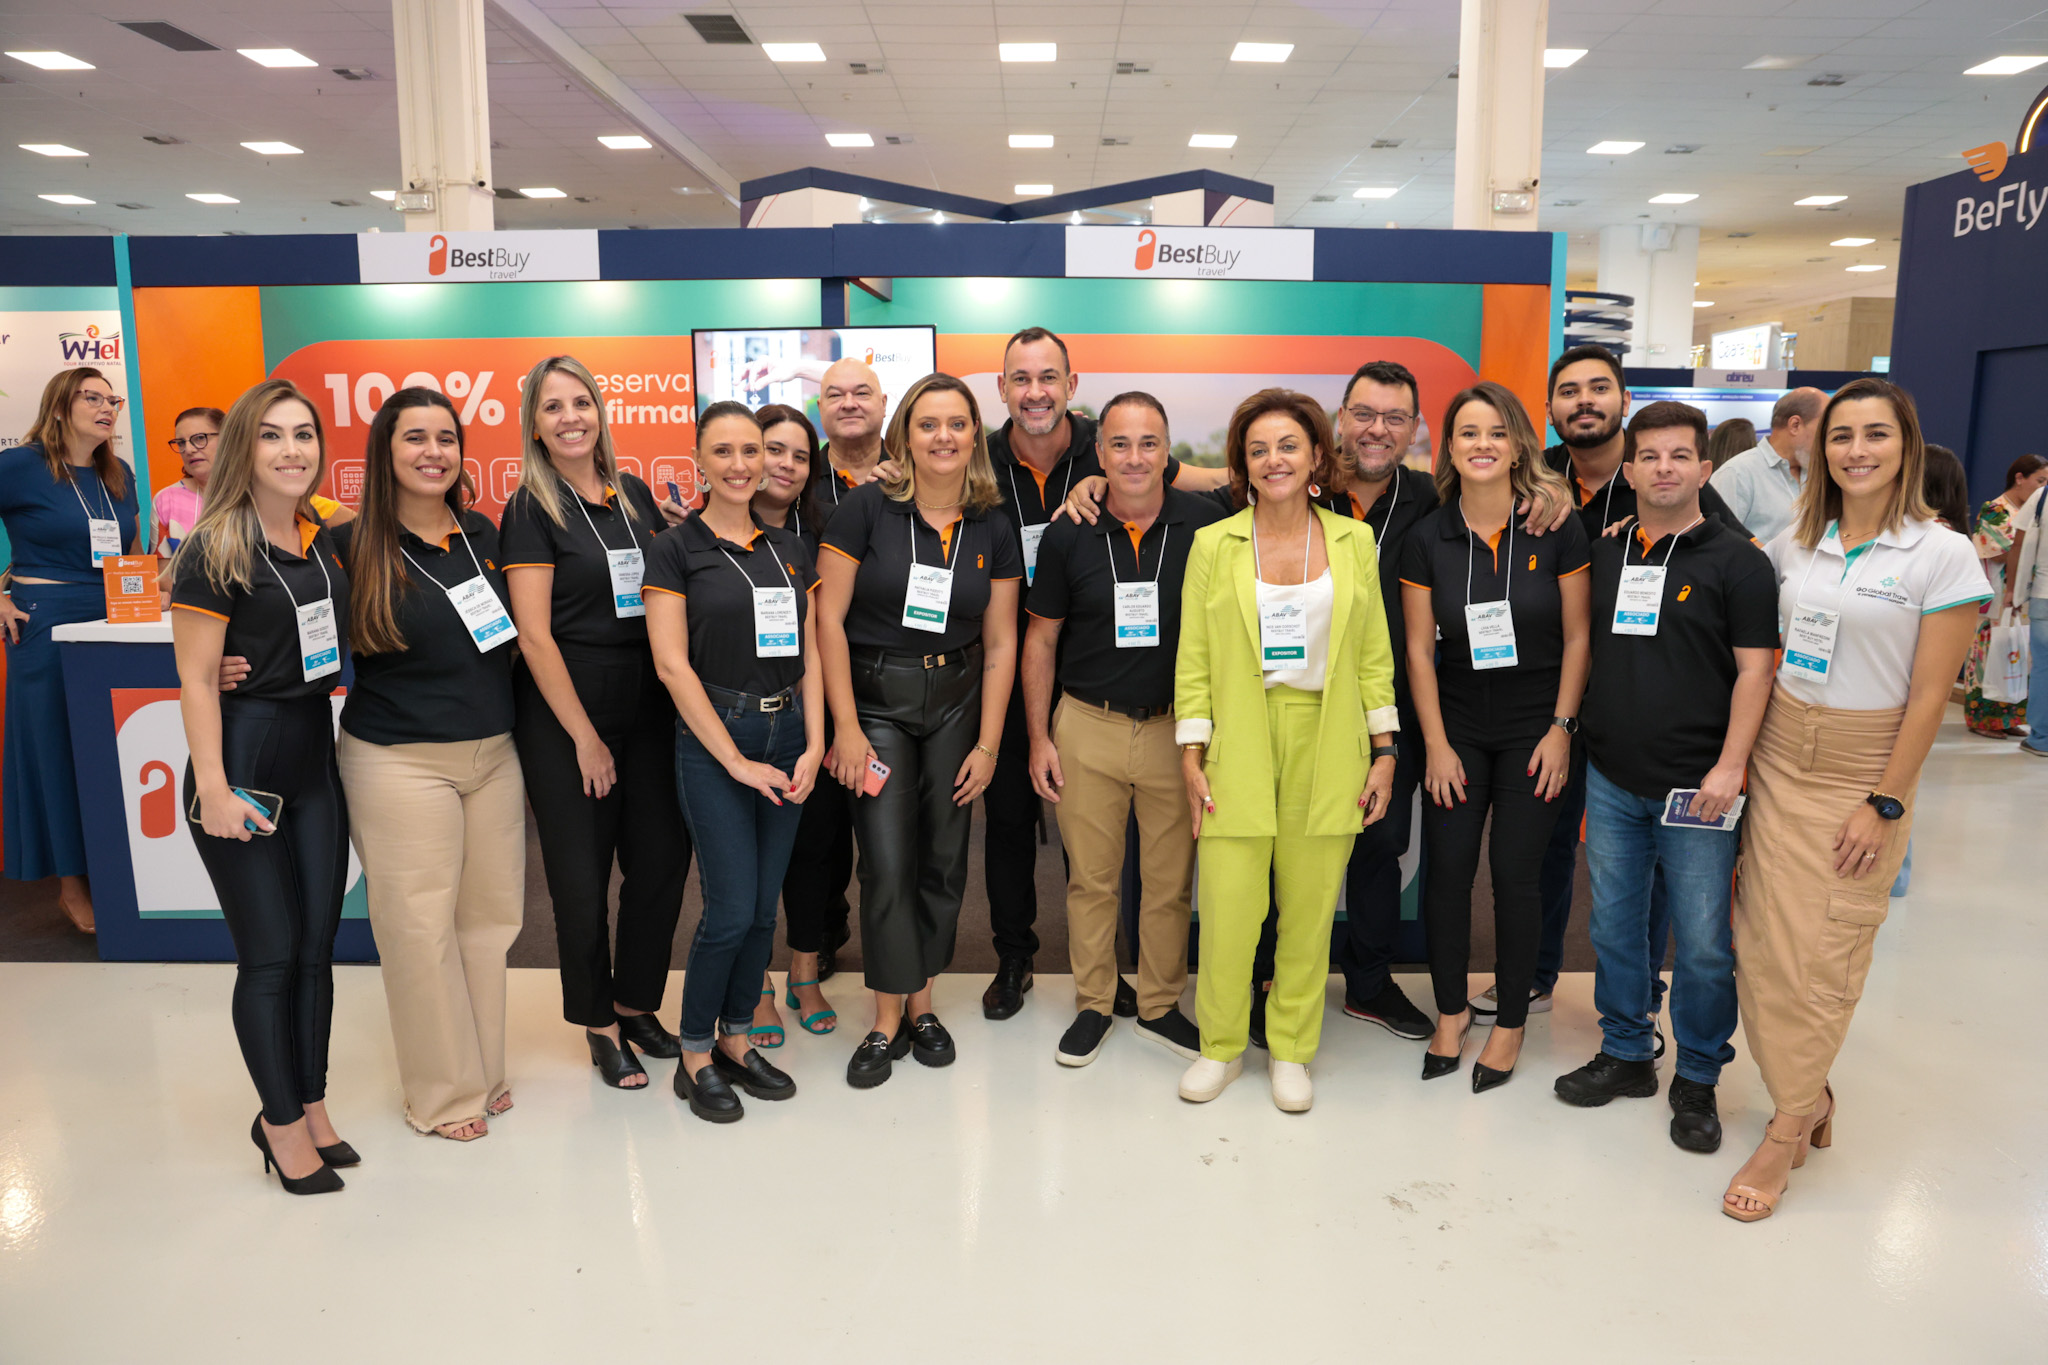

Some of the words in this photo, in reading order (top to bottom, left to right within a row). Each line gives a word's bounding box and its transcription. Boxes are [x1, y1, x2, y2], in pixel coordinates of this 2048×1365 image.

[1954, 181, 2048, 238] BeFly
[451, 247, 530, 272] BestBuy
[1158, 244, 1241, 270] BestBuy
[490, 270, 517, 279] travel
[1198, 267, 1226, 276] travel
[1868, 588, 1892, 598] Global
[913, 610, 938, 618] EXPOSITOR
[1802, 616, 1818, 624] ABAV
[1794, 652, 1821, 664] ASSOCIADO
